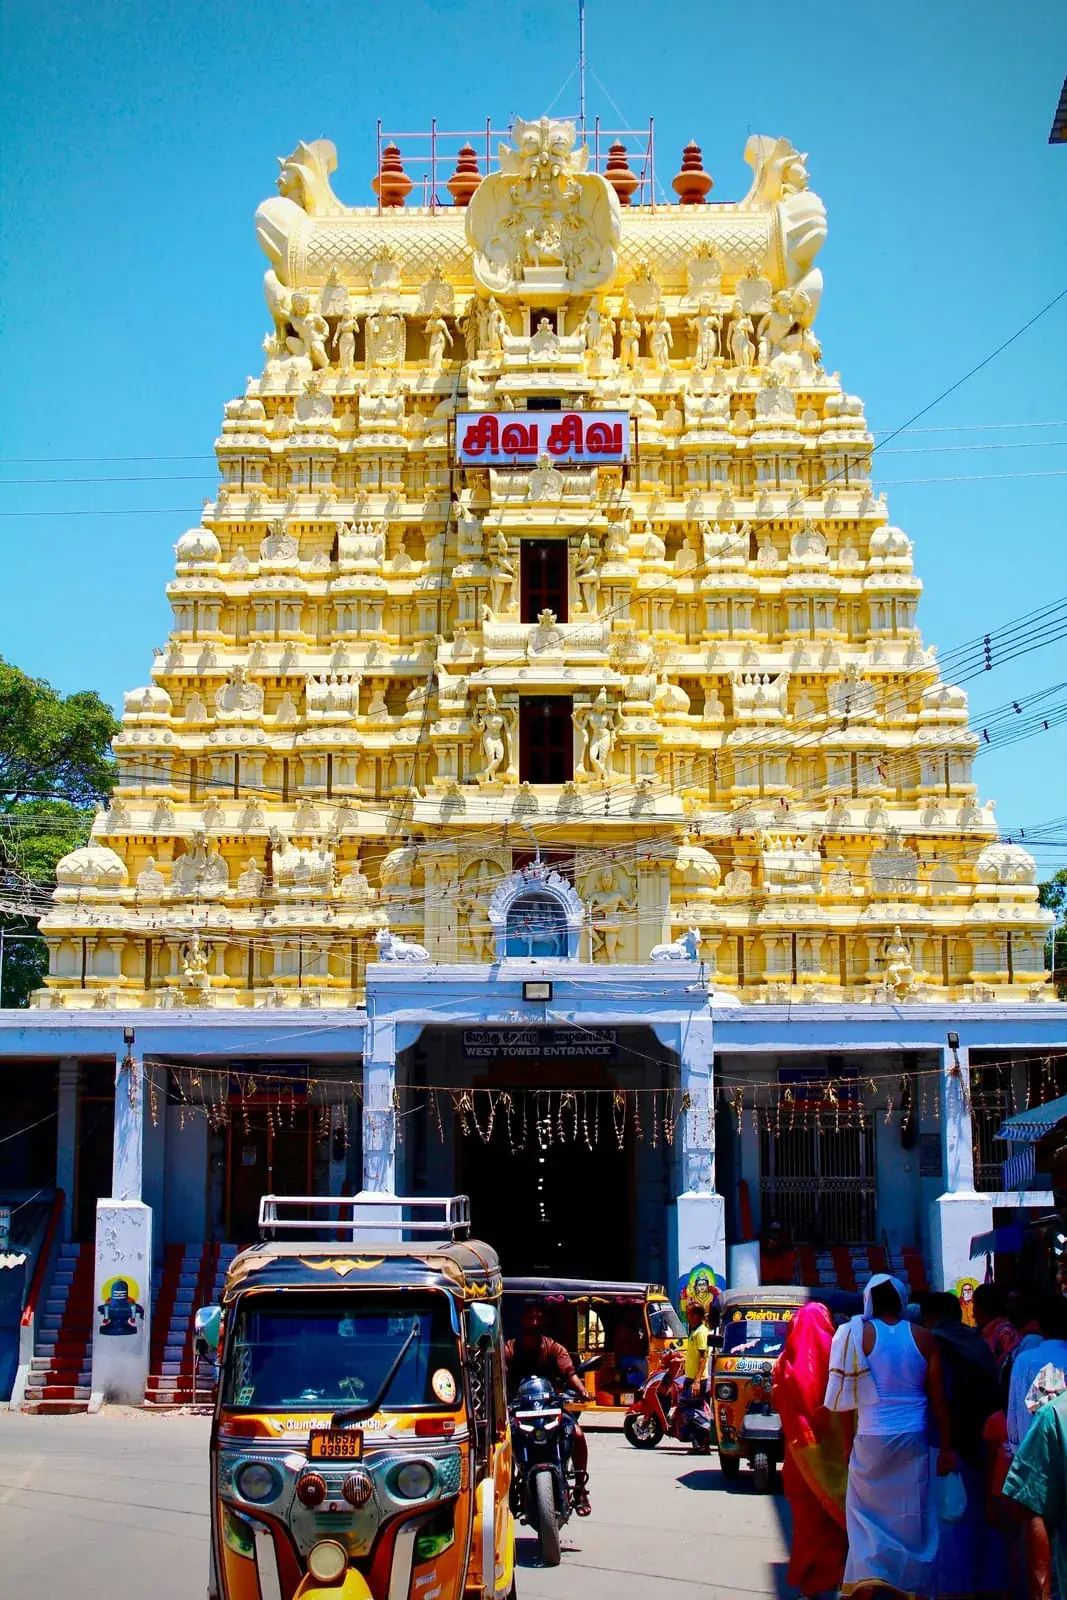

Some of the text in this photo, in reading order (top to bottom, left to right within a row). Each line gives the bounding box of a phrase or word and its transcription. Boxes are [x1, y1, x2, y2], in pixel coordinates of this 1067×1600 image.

[463, 414, 623, 456] சிவ சிவ
[465, 1046, 611, 1056] WEST TOWER ENTRANCE
